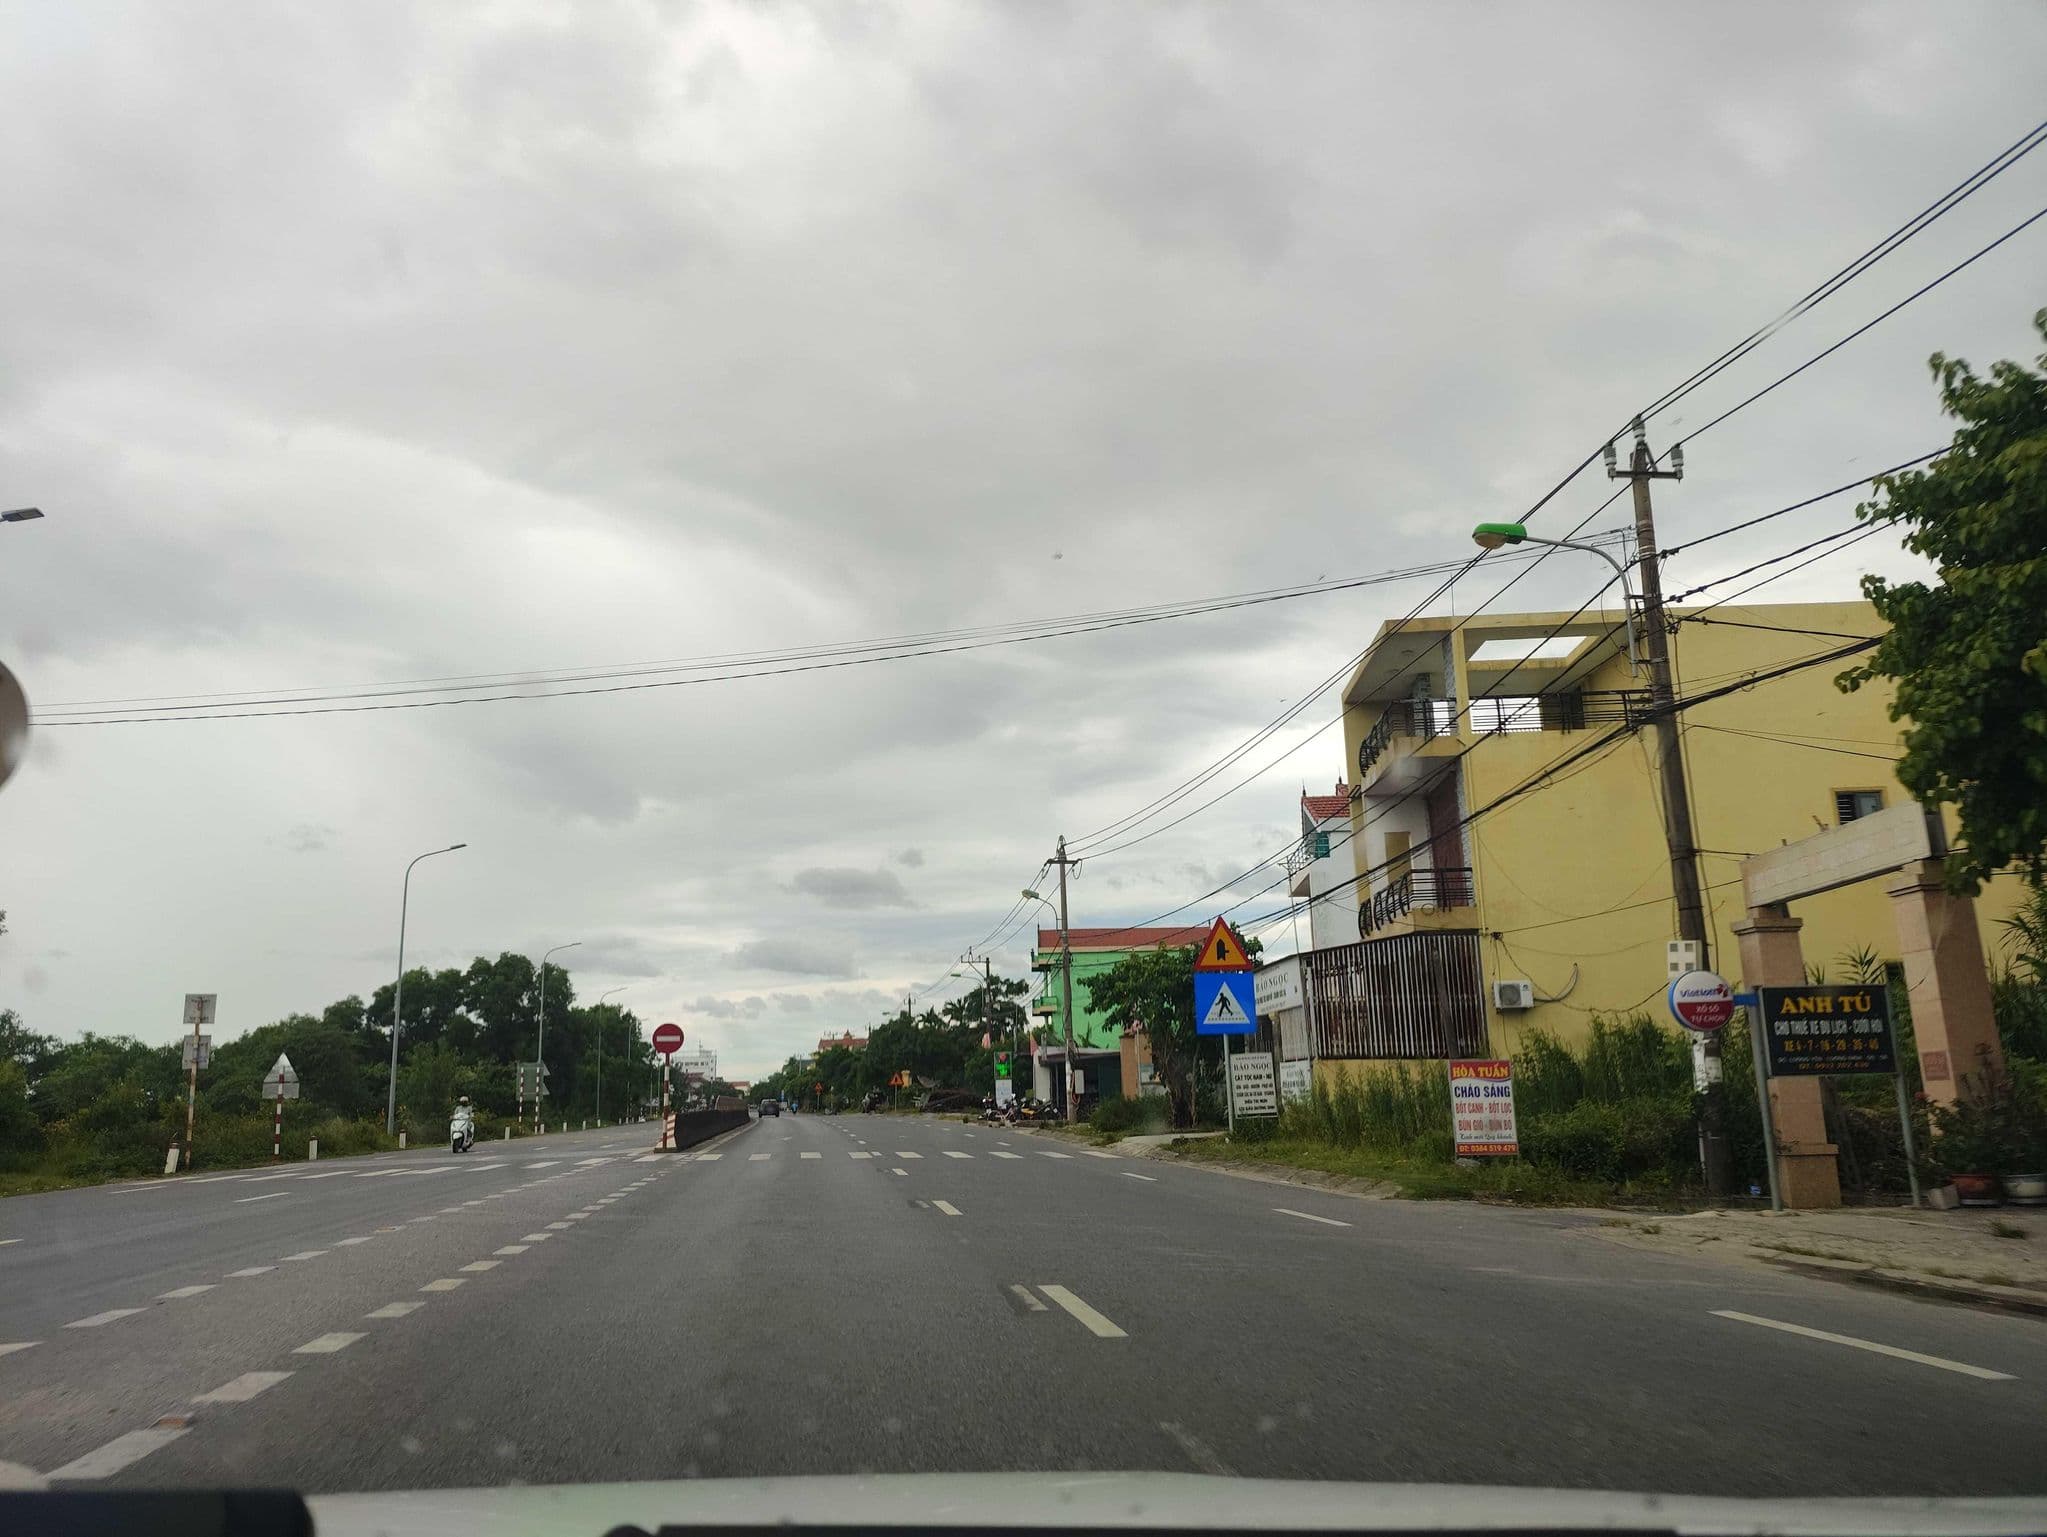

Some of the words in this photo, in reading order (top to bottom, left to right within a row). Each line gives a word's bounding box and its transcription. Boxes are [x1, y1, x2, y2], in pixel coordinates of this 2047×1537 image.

[1780, 996, 1834, 1014] ANH
[1838, 991, 1871, 1013] TÚ
[1452, 1064, 1476, 1078] HÒA
[1478, 1062, 1509, 1078] TUẤN
[1454, 1083, 1481, 1098] CHÁO
[1483, 1083, 1511, 1098] SÁNG
